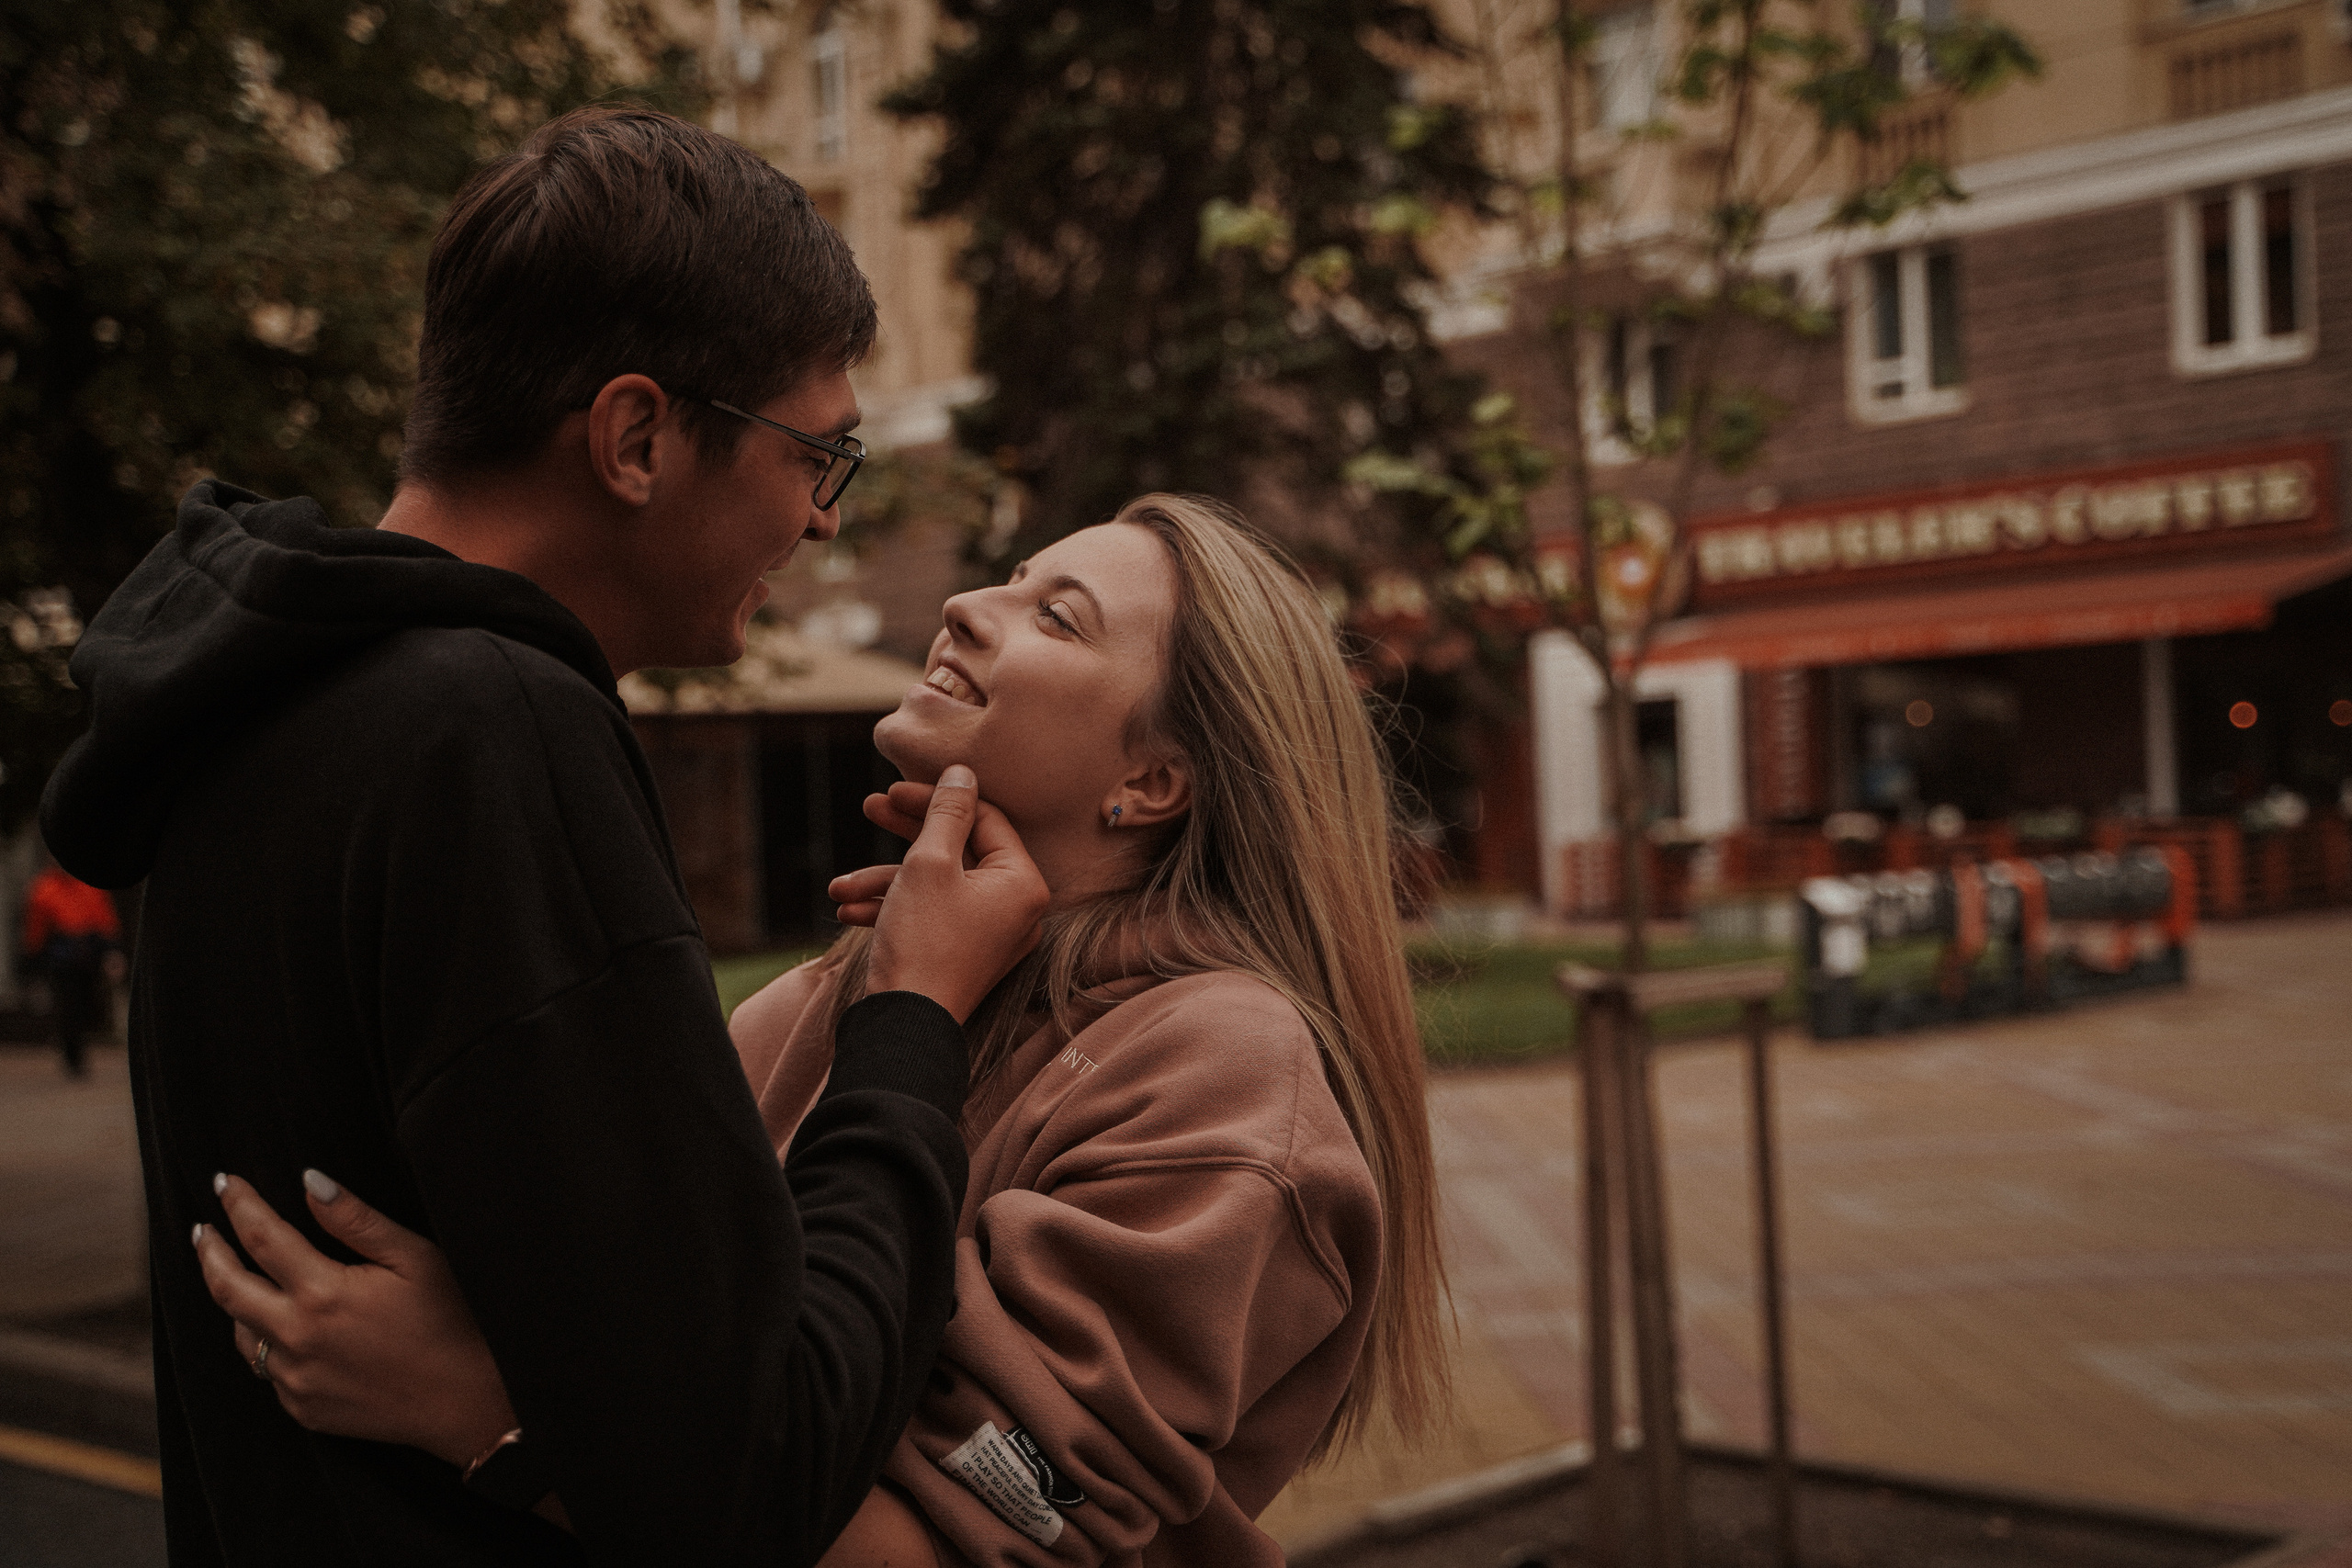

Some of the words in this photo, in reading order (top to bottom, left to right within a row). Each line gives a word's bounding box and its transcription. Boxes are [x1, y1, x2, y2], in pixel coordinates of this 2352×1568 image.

[962, 1461, 974, 1473] OF
[972, 1472, 989, 1490] THE
[986, 1487, 1014, 1515] WORLD
[1012, 1511, 1031, 1528] CAN
[974, 1456, 993, 1478] PLAY
[989, 1475, 1004, 1491] SO
[1001, 1487, 1023, 1508] THAT
[1021, 1506, 1052, 1525] PEOPLE
[980, 1446, 992, 1458] HAT
[989, 1457, 1013, 1485] PEACEFUL
[1011, 1483, 1029, 1501] EVERY
[1026, 1499, 1039, 1508] DAY
[988, 1438, 1003, 1459] WARM
[1000, 1455, 1014, 1473] DAYS
[1012, 1471, 1024, 1484] AND
[1021, 1481, 1038, 1497] QUIET
